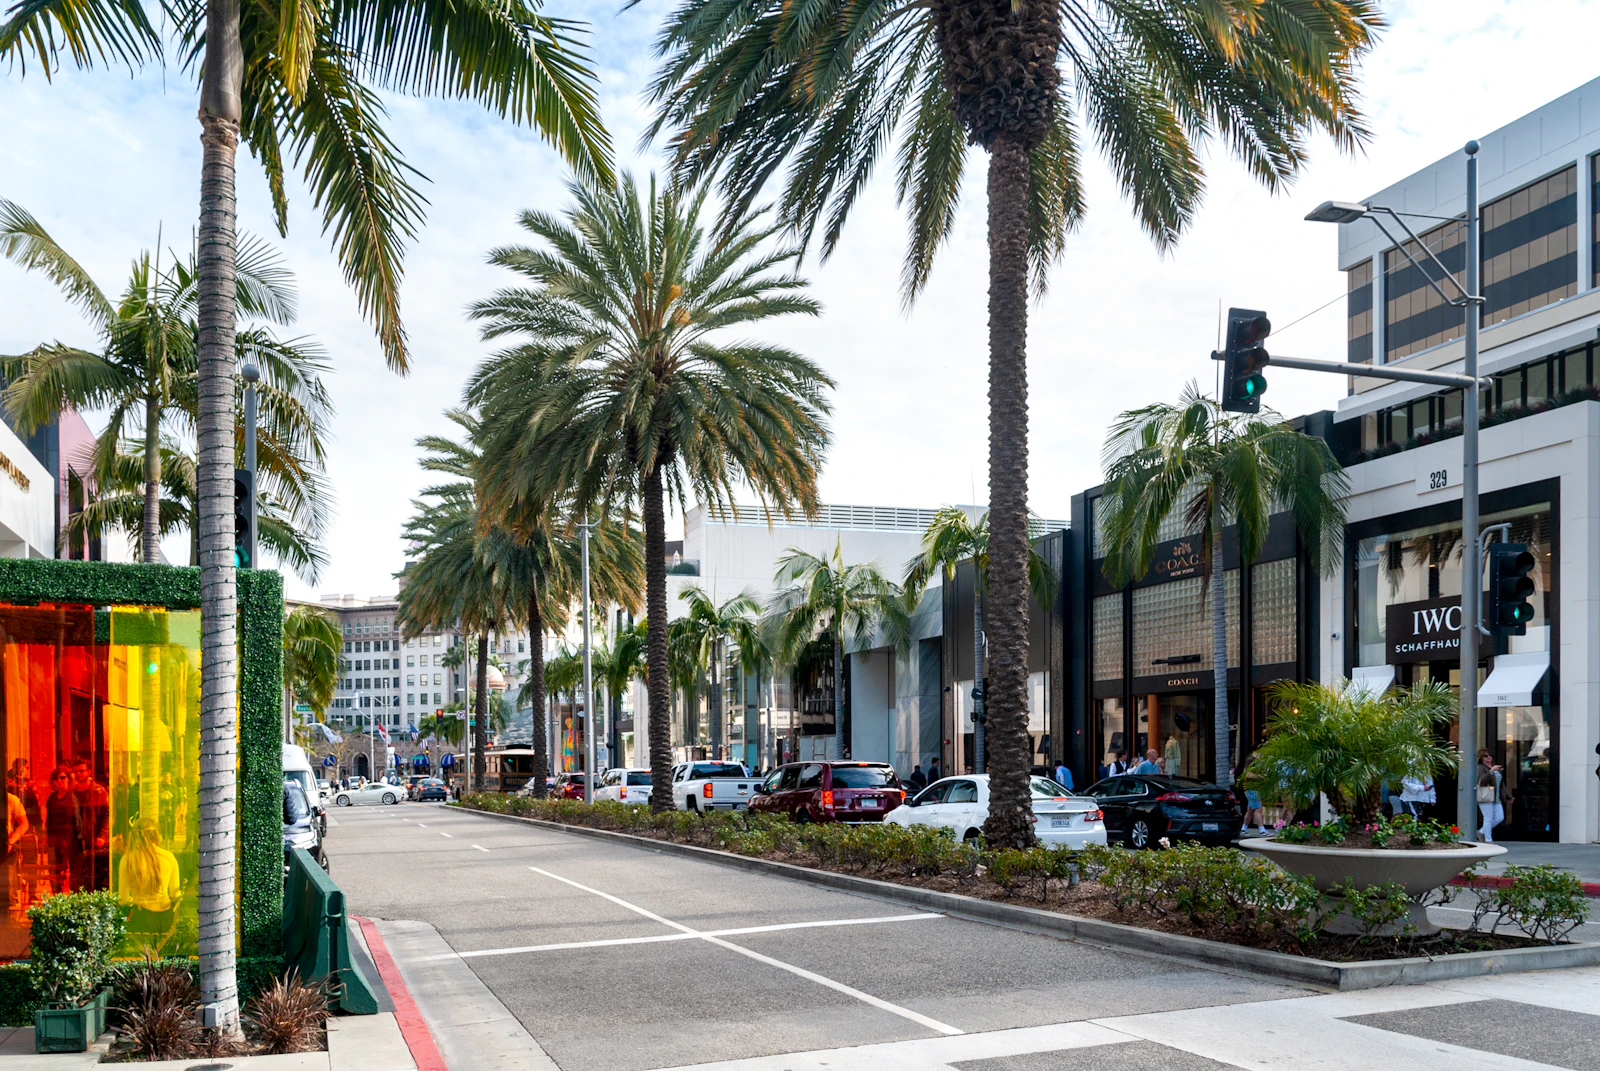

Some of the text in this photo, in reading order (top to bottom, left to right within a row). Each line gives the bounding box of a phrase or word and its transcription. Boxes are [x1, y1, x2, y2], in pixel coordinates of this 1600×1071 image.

[1430, 469, 1447, 489] 329
[1155, 554, 1204, 574] COAC
[1412, 605, 1463, 635] IWC
[1395, 638, 1460, 653] SCHAFFHAU
[1167, 677, 1199, 686] COACH
